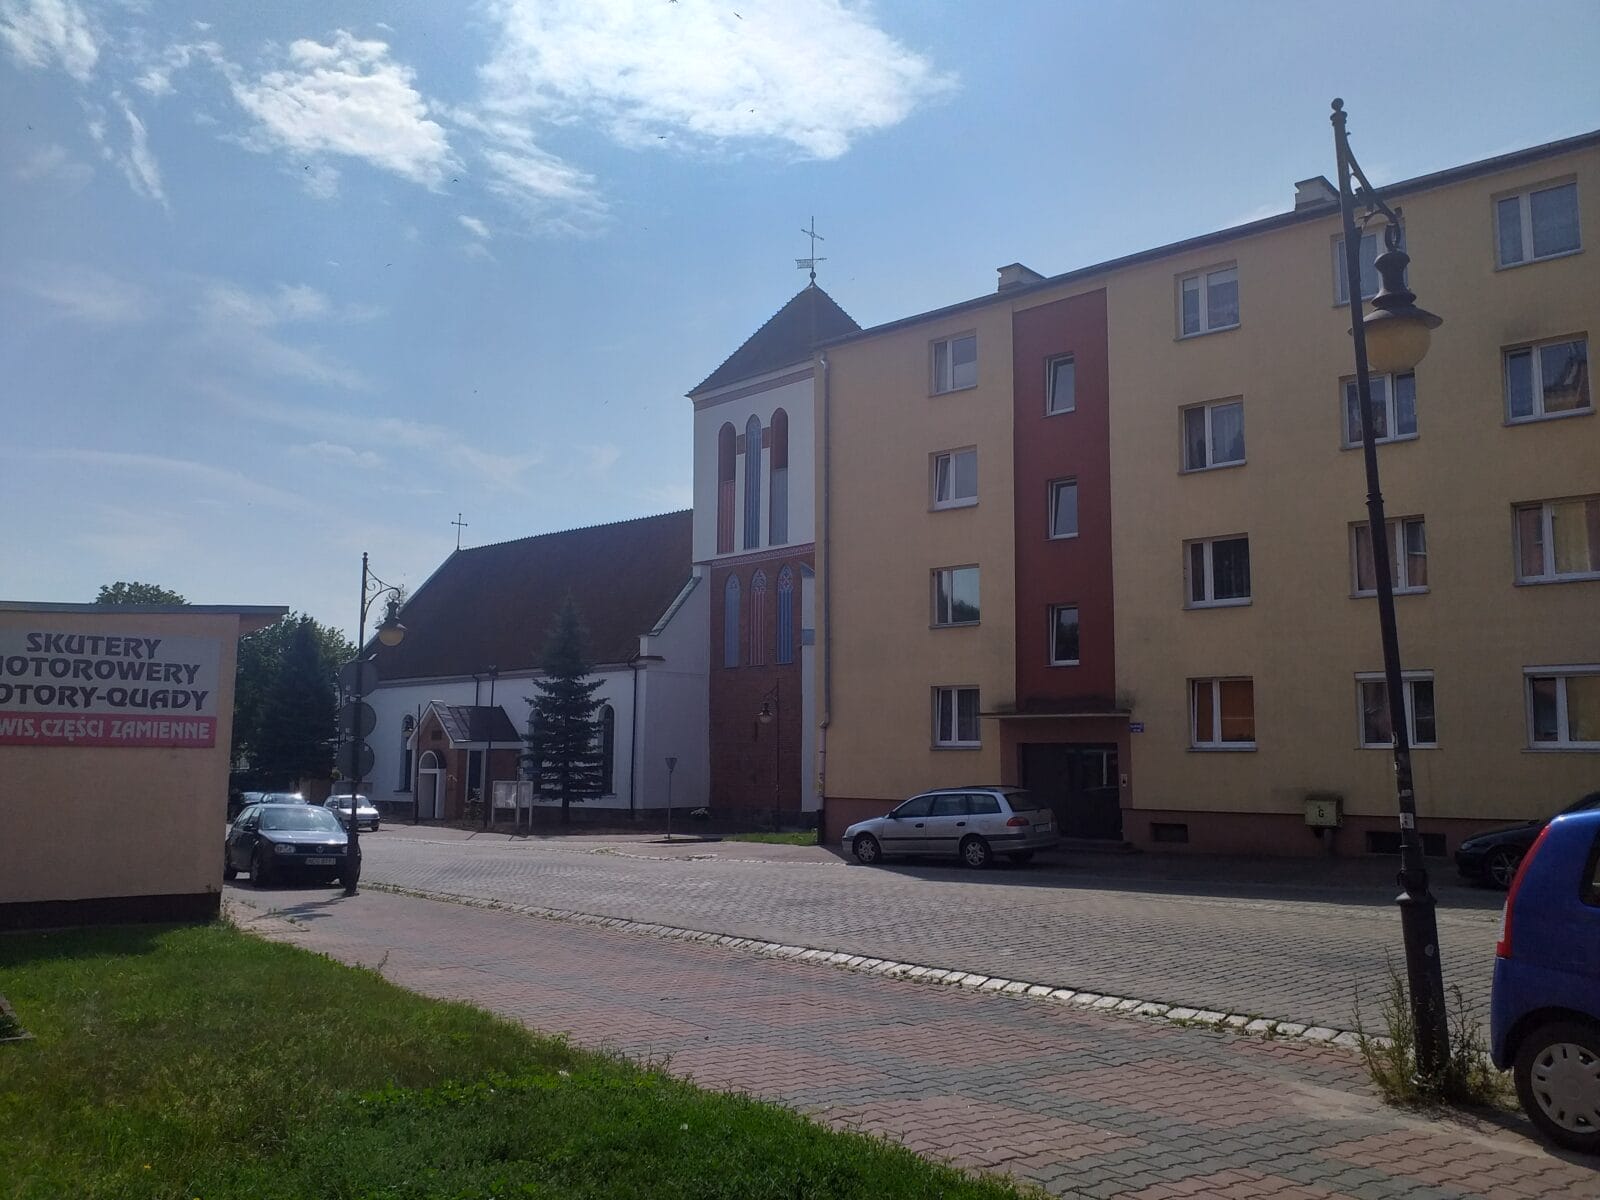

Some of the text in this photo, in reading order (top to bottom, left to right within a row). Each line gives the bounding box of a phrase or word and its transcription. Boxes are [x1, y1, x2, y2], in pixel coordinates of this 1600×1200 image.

[26, 632, 162, 659] SKUTERY
[0, 655, 201, 685] OTOROWERY
[109, 719, 210, 740] ZAMIENNE
